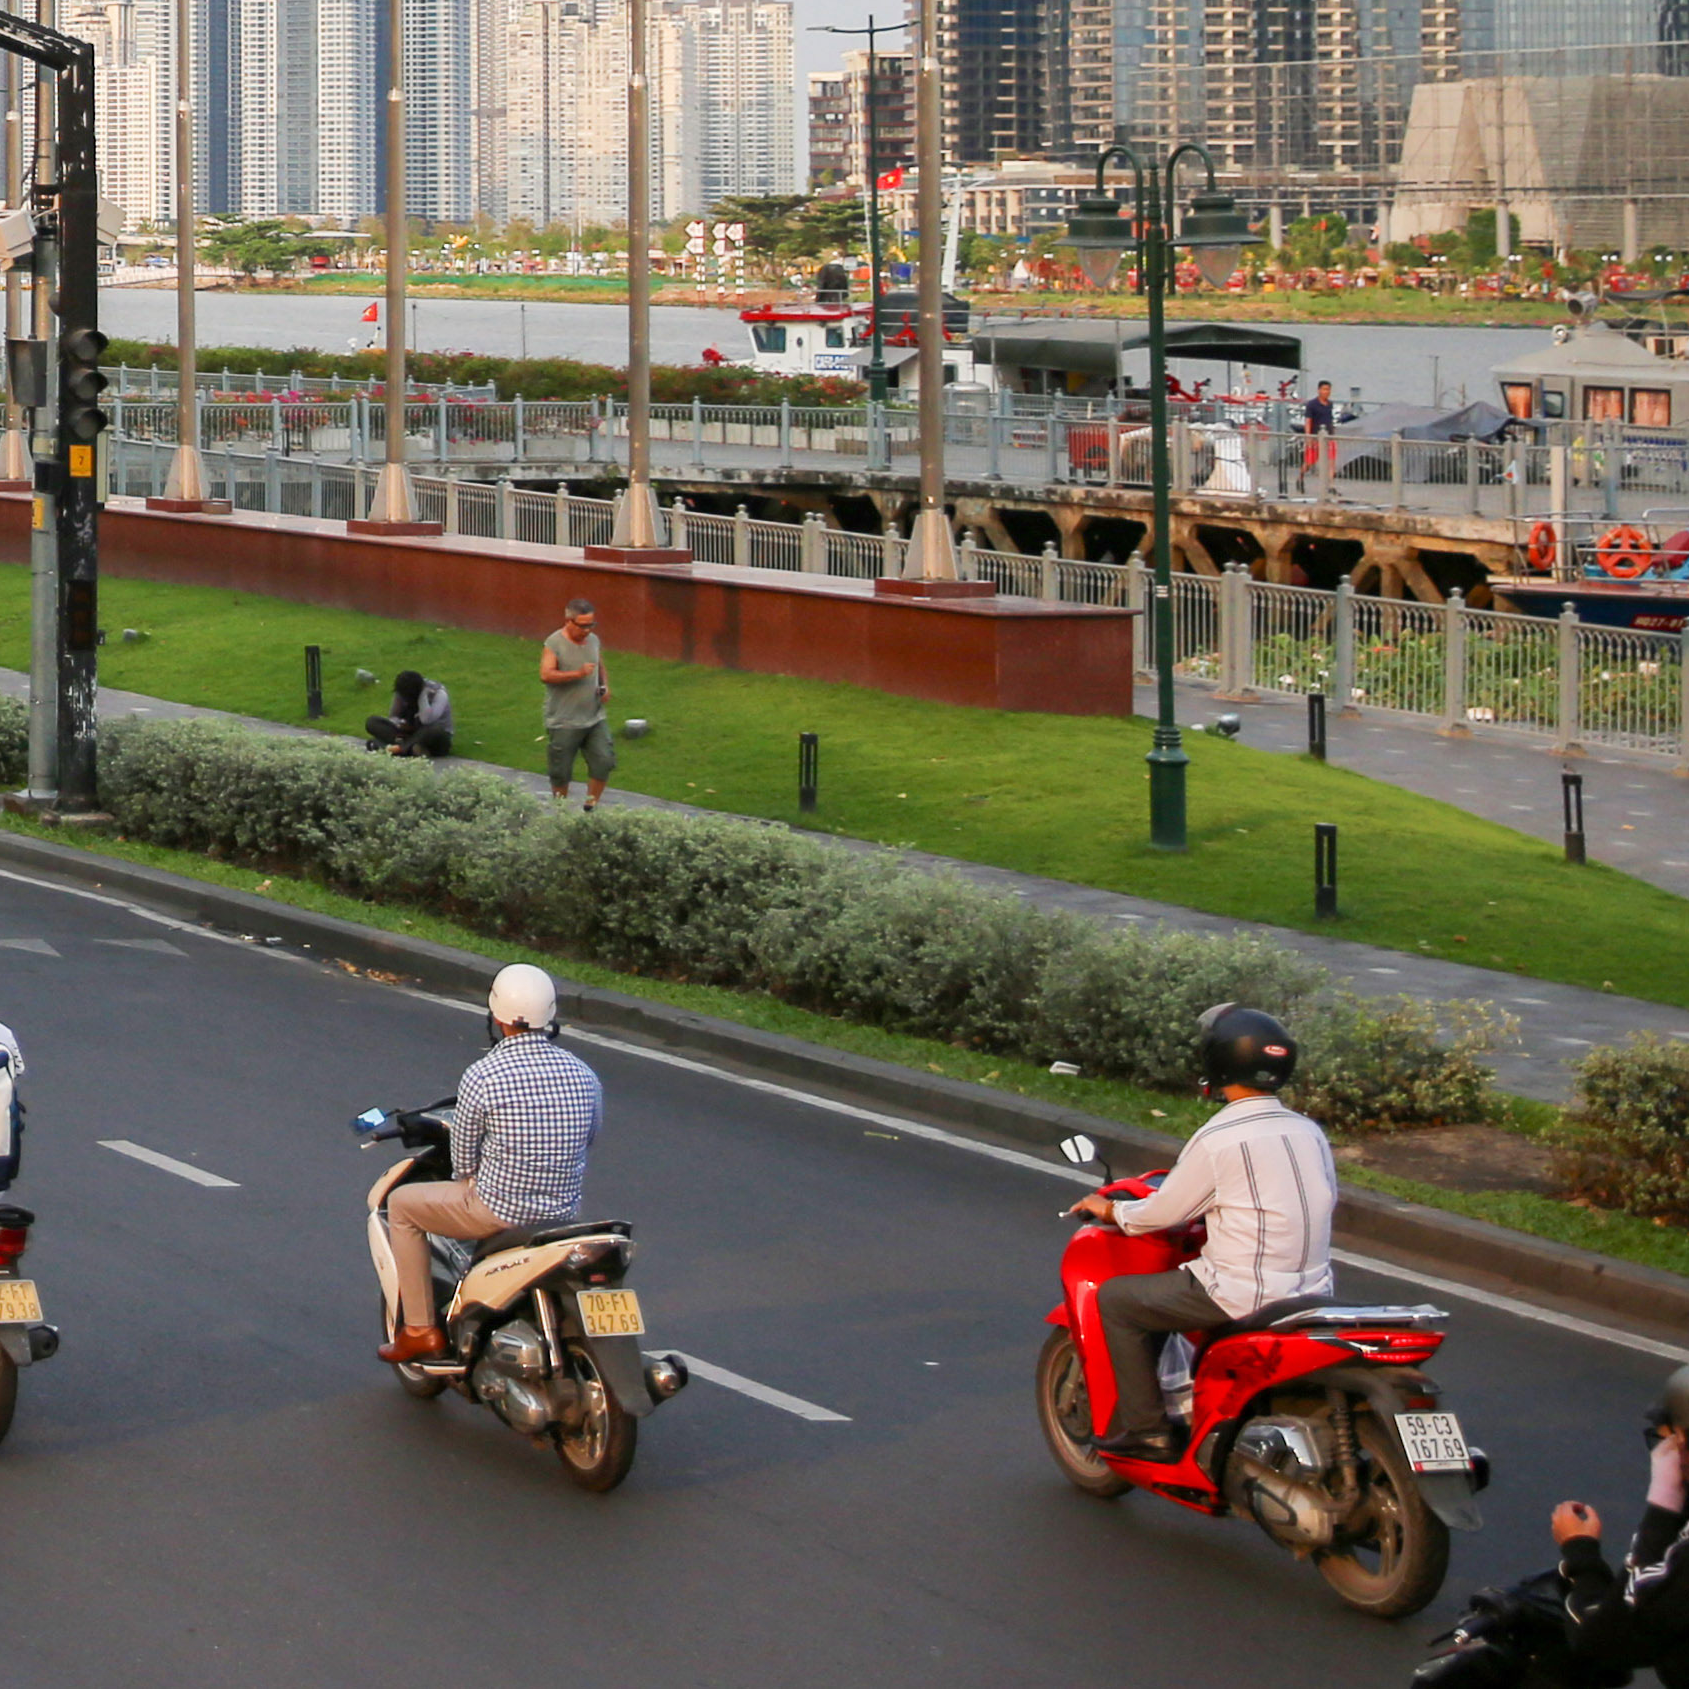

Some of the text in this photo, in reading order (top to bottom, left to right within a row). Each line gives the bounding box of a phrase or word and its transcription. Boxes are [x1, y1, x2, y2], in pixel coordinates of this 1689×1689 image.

[586, 1293, 629, 1312] 70-F1
[1406, 1415, 1453, 1436] 59-C3
[1411, 1438, 1465, 1459] 167.69
